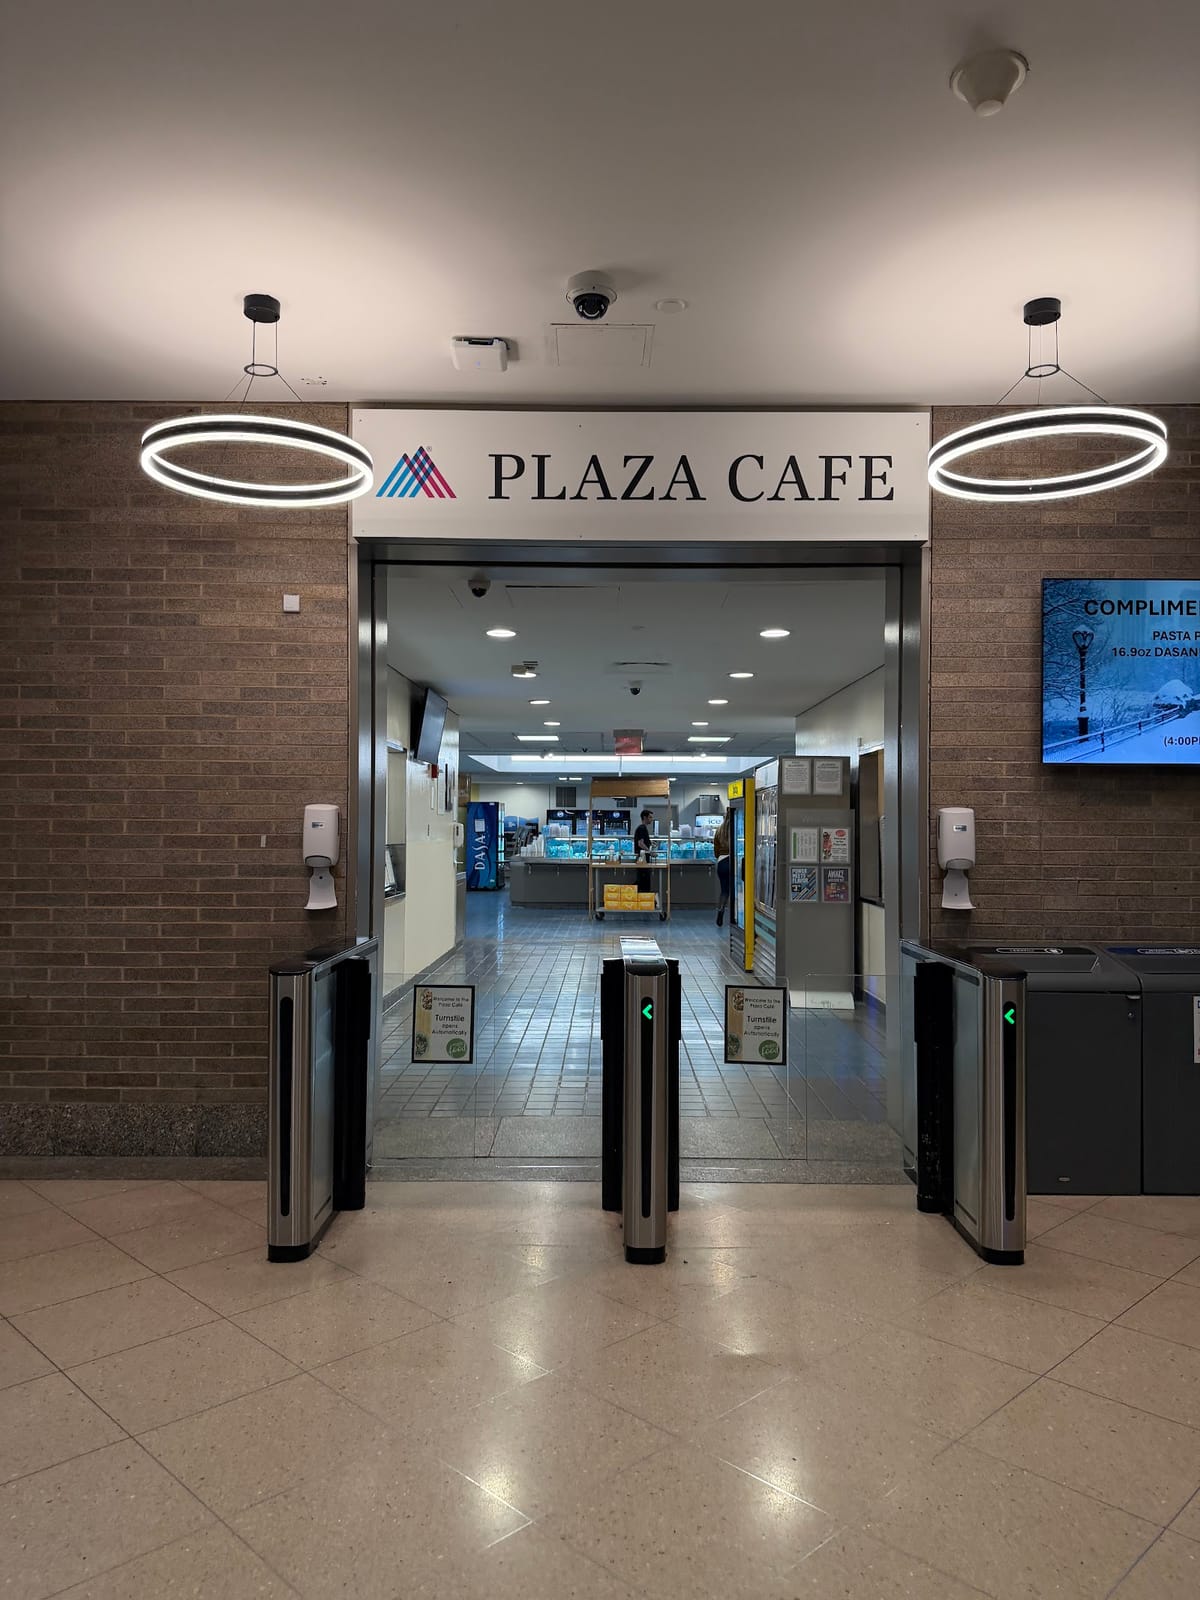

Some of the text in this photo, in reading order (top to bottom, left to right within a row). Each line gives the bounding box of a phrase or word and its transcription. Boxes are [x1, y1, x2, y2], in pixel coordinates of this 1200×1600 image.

[488, 453, 895, 502] PLAZA CAFE
[1084, 600, 1200, 616] COMPLIME
[1153, 631, 1191, 641] PASTA
[1112, 647, 1151, 657] 16.9oz
[1164, 735, 1200, 748] (4:00P
[472, 834, 488, 870] DASA
[435, 1014, 465, 1022] Turnstile
[747, 1015, 777, 1023] Turnstile
